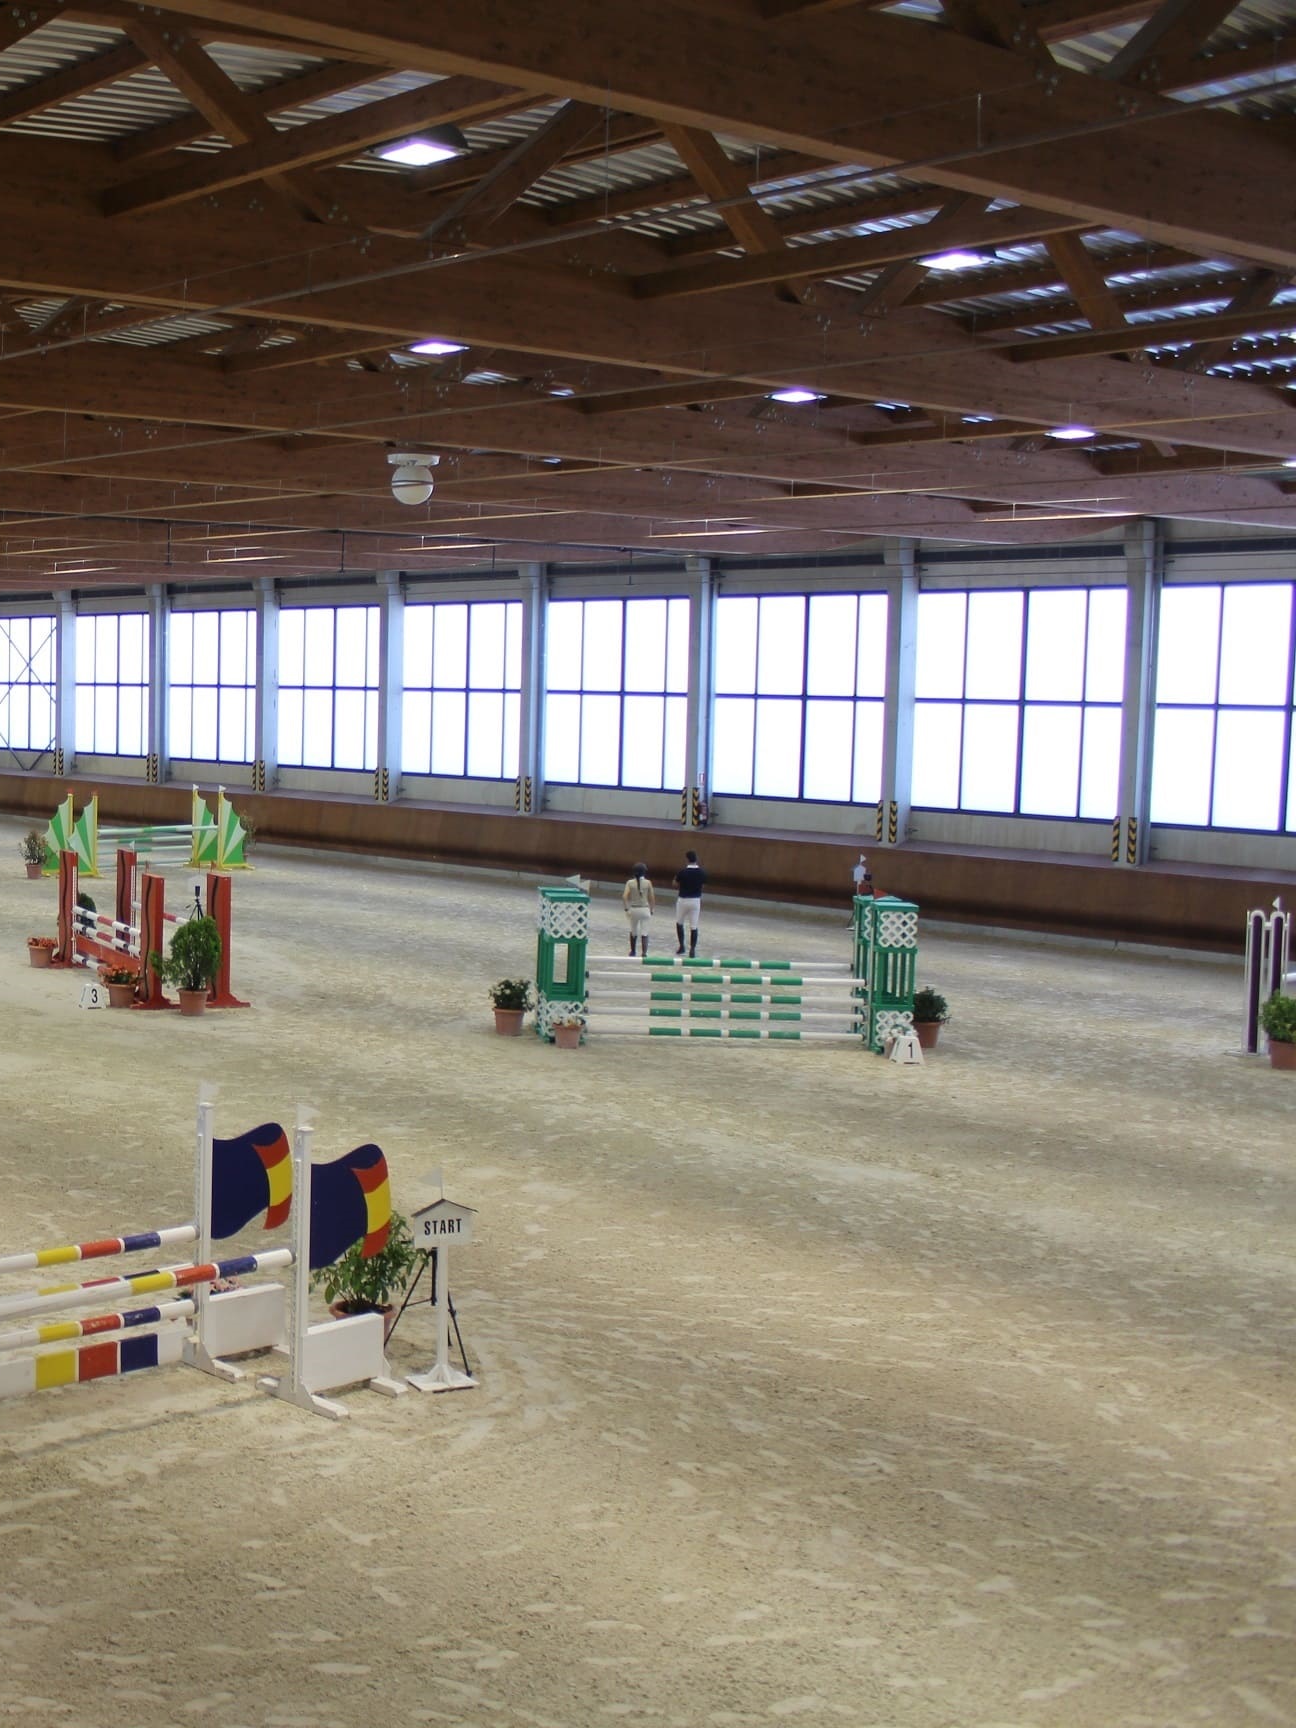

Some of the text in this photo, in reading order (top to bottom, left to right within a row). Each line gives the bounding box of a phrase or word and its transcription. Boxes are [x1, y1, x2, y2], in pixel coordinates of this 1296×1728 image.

[91, 988, 98, 1004] 3
[907, 1041, 913, 1059] 1
[424, 1218, 462, 1236] START
